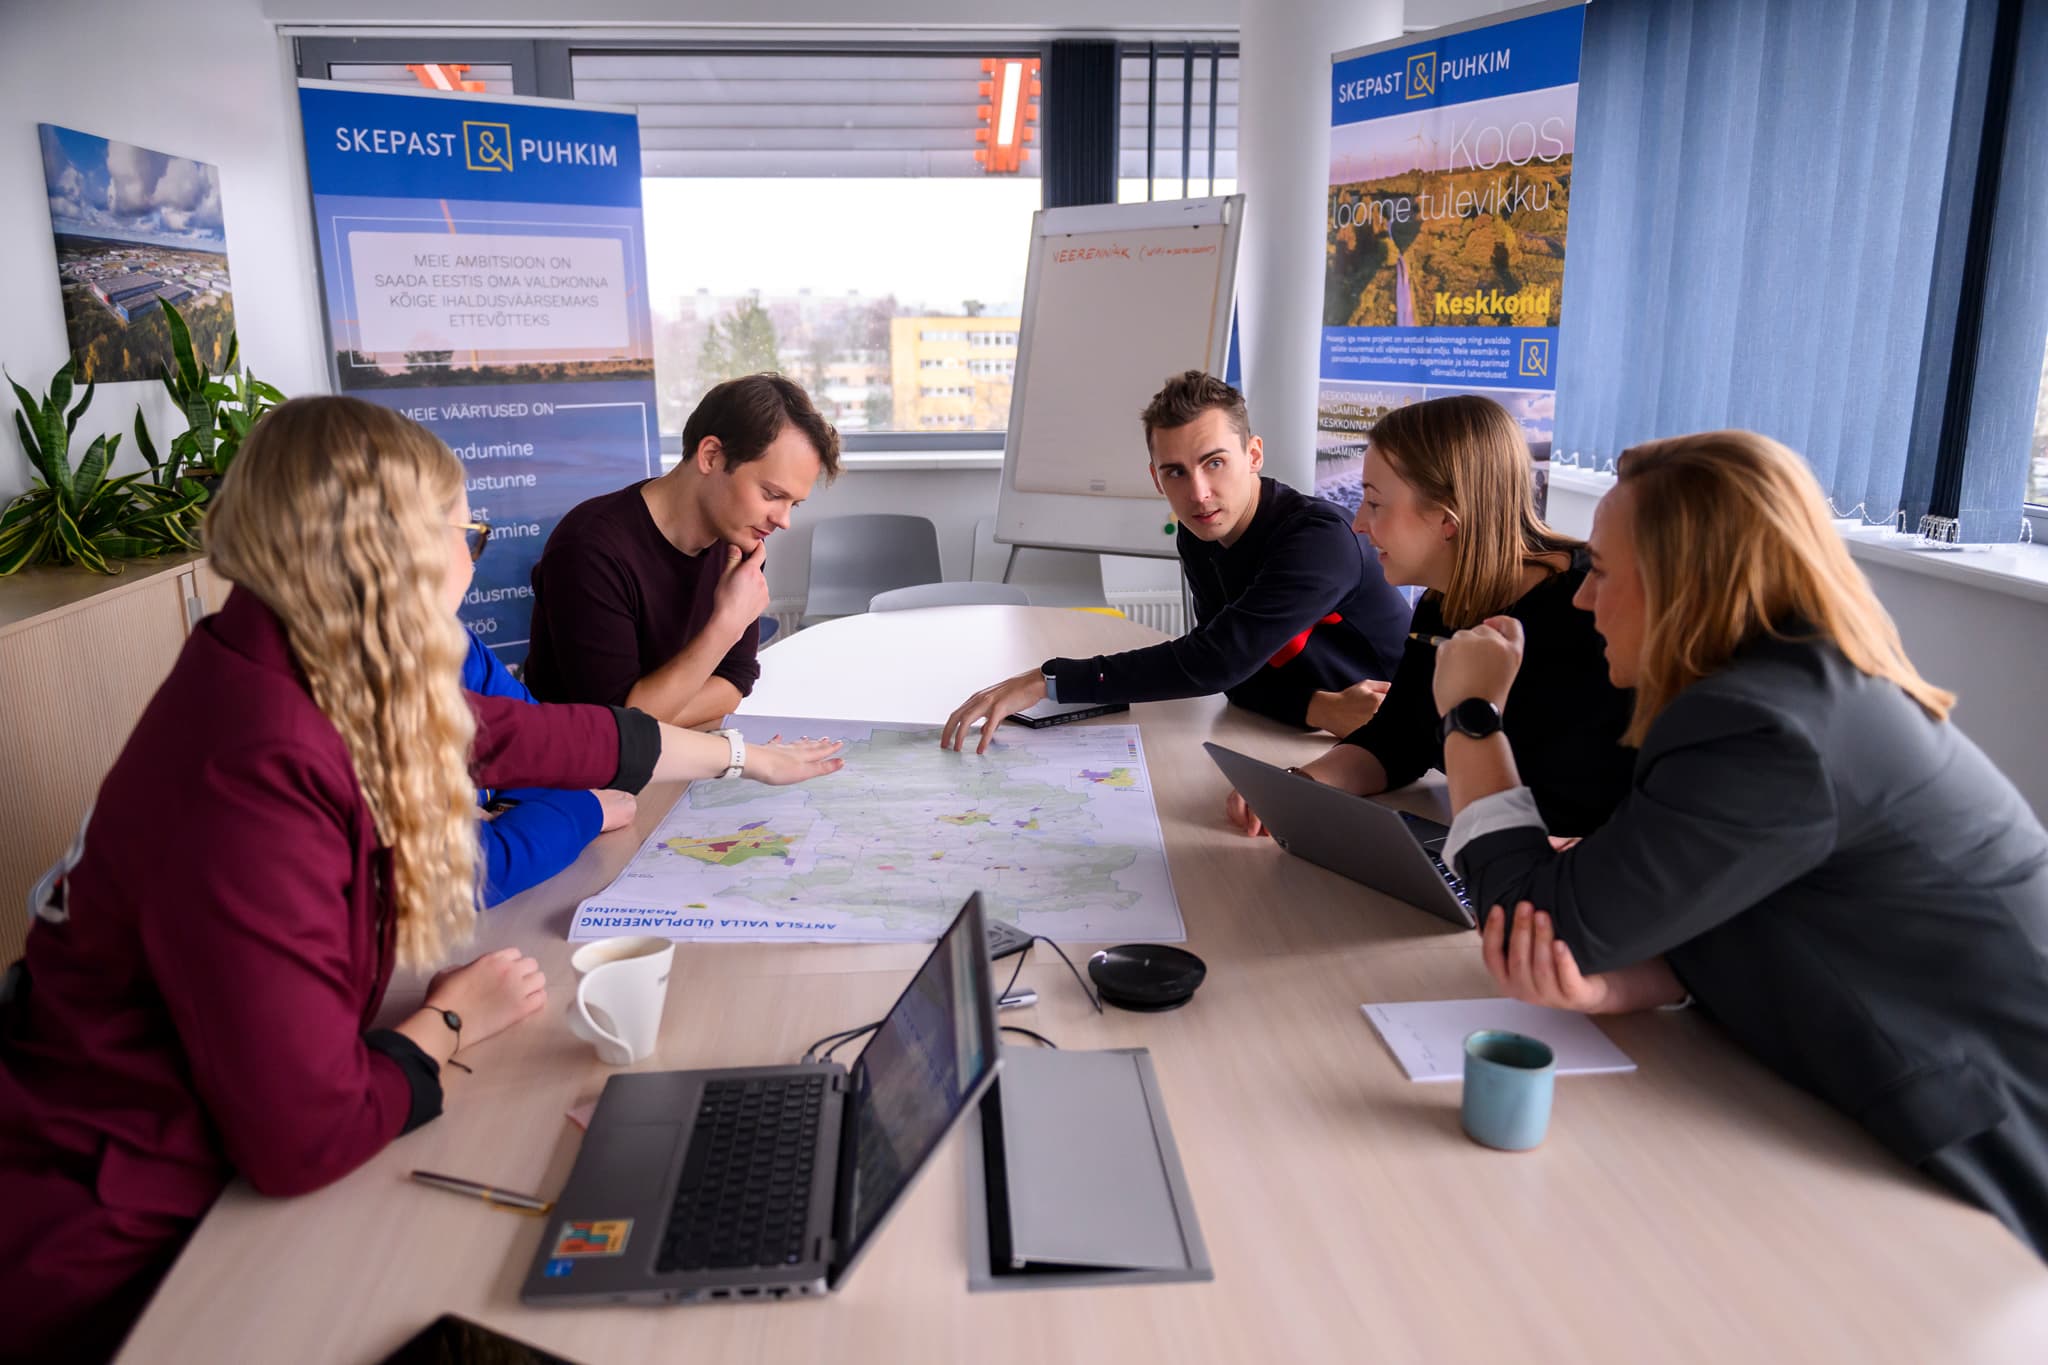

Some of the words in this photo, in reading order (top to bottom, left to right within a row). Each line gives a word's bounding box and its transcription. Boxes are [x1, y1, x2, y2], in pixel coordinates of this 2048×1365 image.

[1339, 72, 1403, 104] SKEPAST
[1440, 48, 1511, 83] PUHKIM
[335, 127, 456, 157] SKEPAST
[521, 139, 618, 167] PUHKIM
[1449, 116, 1565, 174] KOOS
[1332, 196, 1411, 230] loome
[1420, 174, 1550, 221] tulevikku
[414, 254, 451, 268] MEIE
[454, 254, 546, 269] AMBITSIOON
[550, 257, 572, 270] ON
[374, 274, 428, 288] SAADA
[432, 274, 484, 289] EESTIS
[488, 275, 522, 289] OMA
[523, 275, 609, 290] VALDKONNA
[389, 291, 438, 309] KÕIGE
[442, 291, 600, 309] IHALDUSVÄÄRSEMAKS
[1435, 288, 1551, 316] Keskkond
[449, 310, 551, 328] ETTEVÕTTEKS
[1371, 335, 1393, 345] projekt
[1468, 336, 1483, 347] ning
[1484, 336, 1511, 346] avaldab
[1452, 347, 1468, 355] Meie
[1470, 347, 1500, 357] eesmärk
[1500, 348, 1511, 357] on
[1455, 358, 1462, 368] ja
[1463, 358, 1479, 367] leida
[1480, 359, 1510, 369] parimad
[1430, 367, 1466, 377] võimalikud
[1467, 369, 1509, 379] lahendused.
[400, 407, 438, 421] MEIE
[443, 403, 529, 420] VÄÄRTUSED
[532, 402, 554, 416] ON
[1367, 408, 1378, 418] JA
[1319, 417, 1376, 431] KESKKONNAM
[452, 441, 534, 461] ndumine
[466, 473, 537, 491] ustunne
[487, 522, 541, 542] amine
[470, 617, 498, 635] töö
[584, 906, 678, 916] Maakasutus
[580, 917, 714, 930] ÜLDPLANEERING
[720, 920, 769, 928] VALLA
[774, 921, 837, 930] ANTSLA
